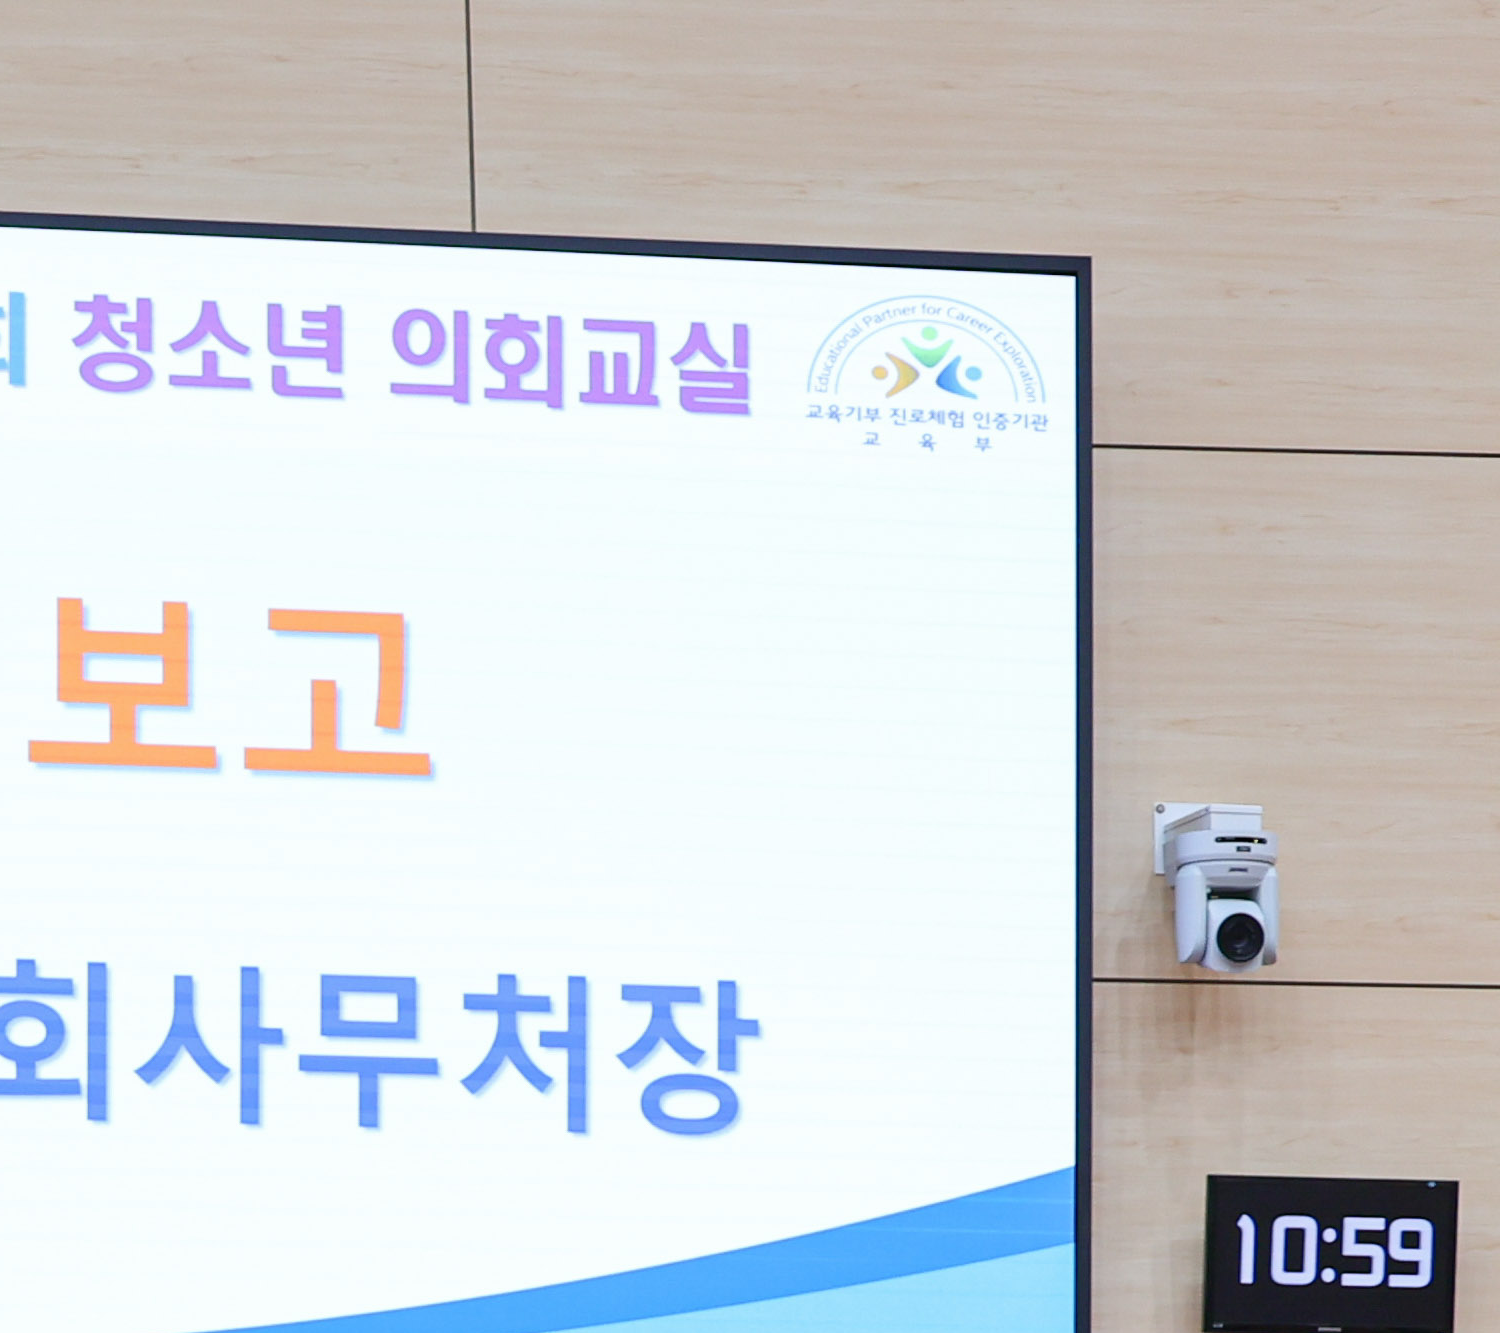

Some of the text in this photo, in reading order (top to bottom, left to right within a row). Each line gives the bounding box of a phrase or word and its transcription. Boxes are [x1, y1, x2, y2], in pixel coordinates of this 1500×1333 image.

[70, 293, 348, 401] 청소년
[389, 307, 753, 417] 의회교실
[814, 302, 1037, 404] Educational Partner for Career Exploration
[805, 403, 1049, 433] 교육기부 진로체험 인증기관
[27, 596, 436, 778] 보고
[1235, 1212, 1436, 1289] 10:59
